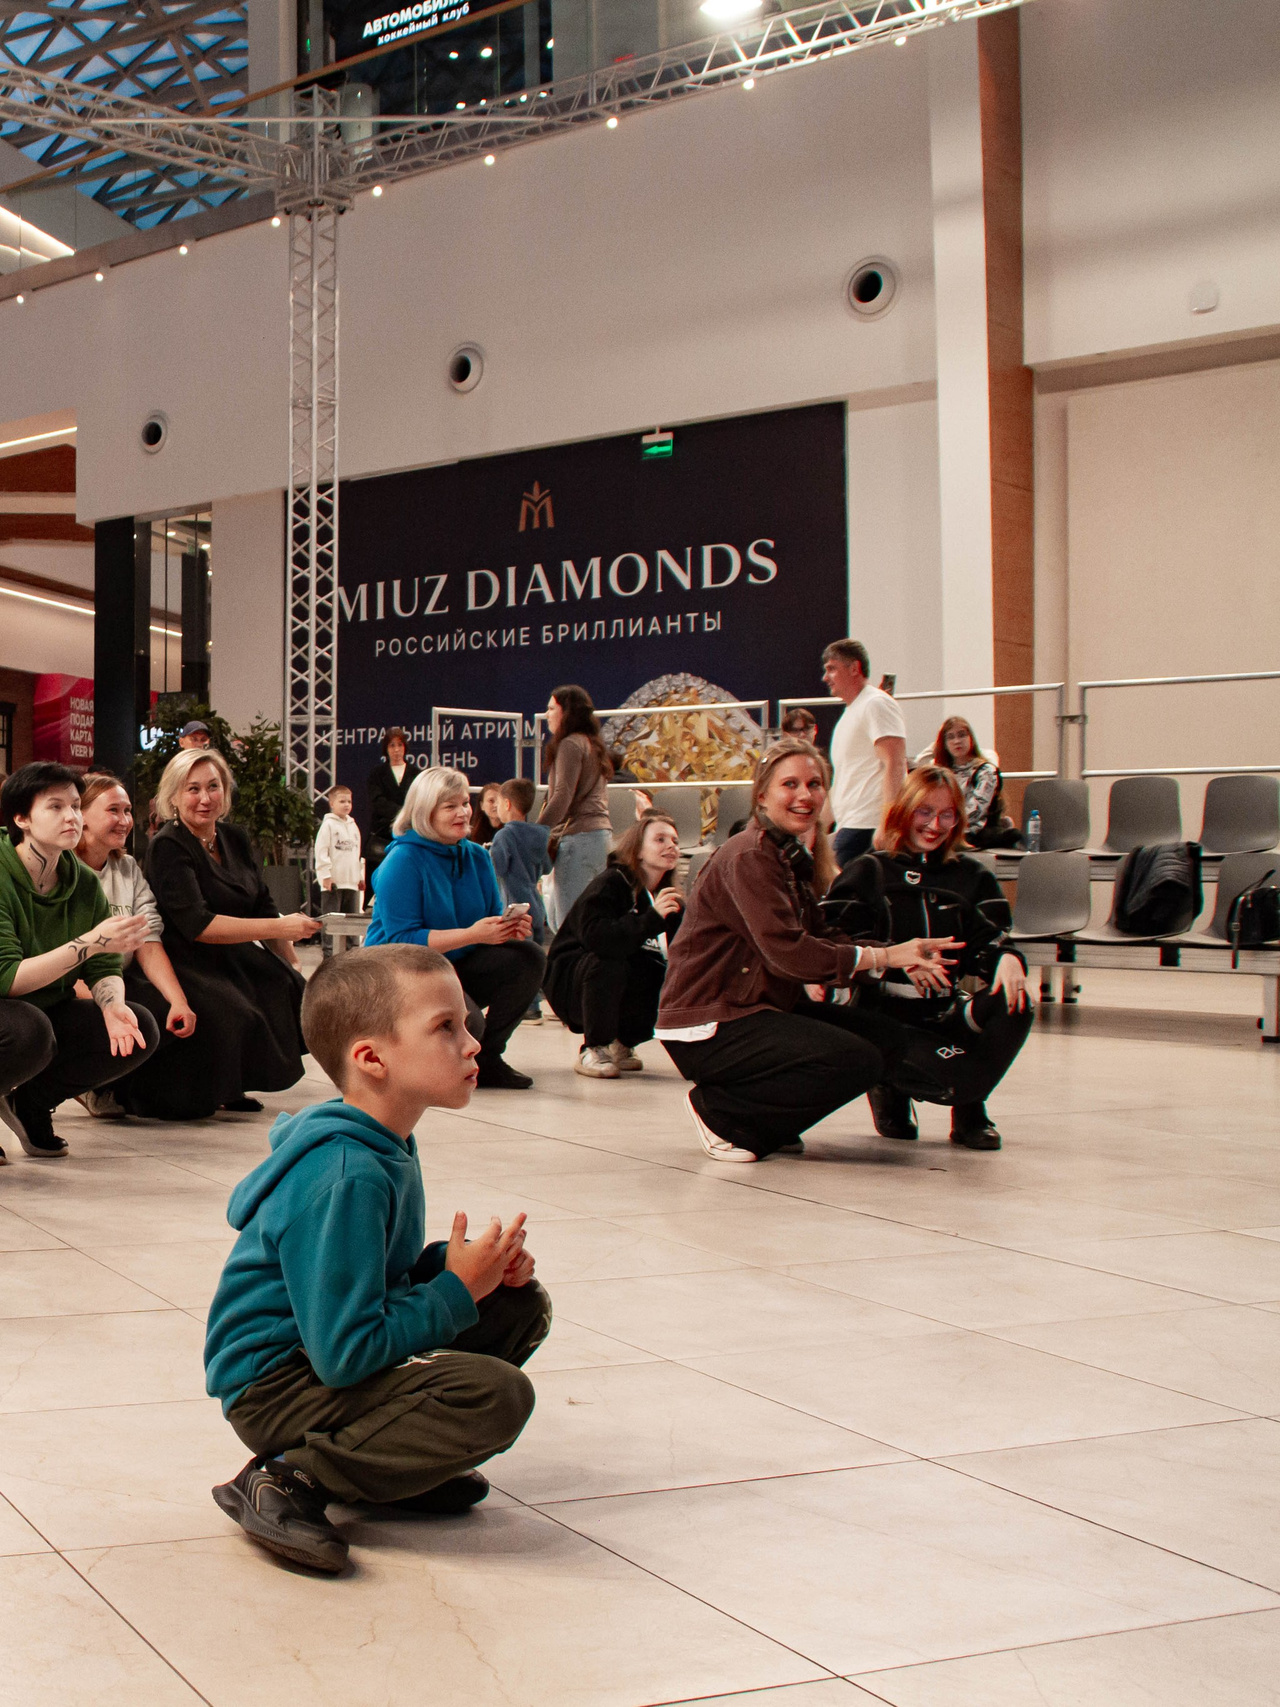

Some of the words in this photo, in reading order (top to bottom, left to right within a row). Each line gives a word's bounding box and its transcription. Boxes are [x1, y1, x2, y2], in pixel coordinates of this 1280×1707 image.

[376, 13, 439, 46] хоккейный
[442, 2, 470, 23] клуб
[337, 573, 449, 623] MIUZ
[466, 537, 779, 611] DIAMONDS
[375, 626, 531, 658] РОССИЙСКИЕ
[541, 610, 722, 645] БРИЛЛИАНТЫ
[69, 696, 94, 712] НОВАЯ
[69, 728, 93, 743] КАРТА
[69, 743, 88, 758] VEER
